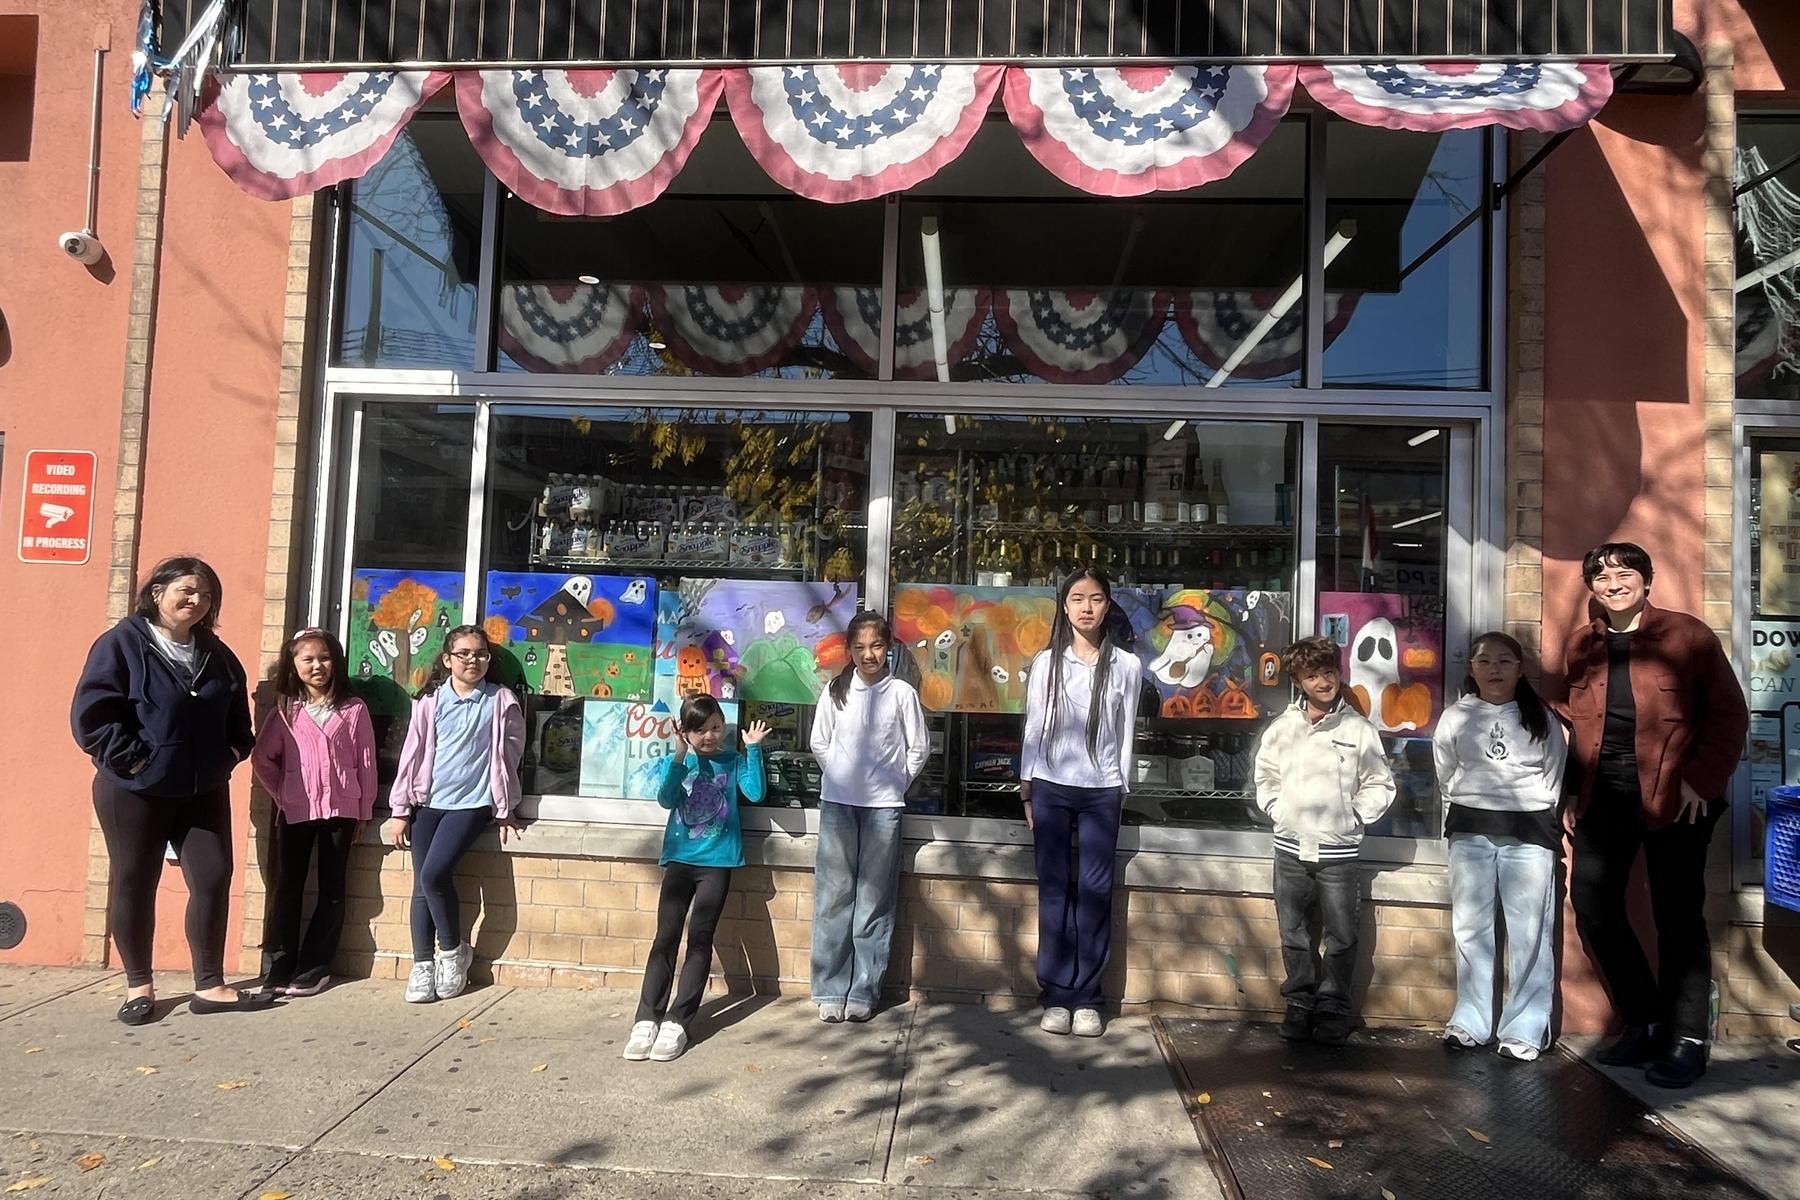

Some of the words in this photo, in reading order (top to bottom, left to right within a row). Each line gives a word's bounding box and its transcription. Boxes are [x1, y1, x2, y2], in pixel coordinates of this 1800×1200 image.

[46, 464, 76, 476] VIDEO
[31, 483, 86, 496] RECORDING
[23, 536, 34, 548] IN
[35, 537, 86, 549] PROGRESS
[1750, 676, 1796, 693] CAN
